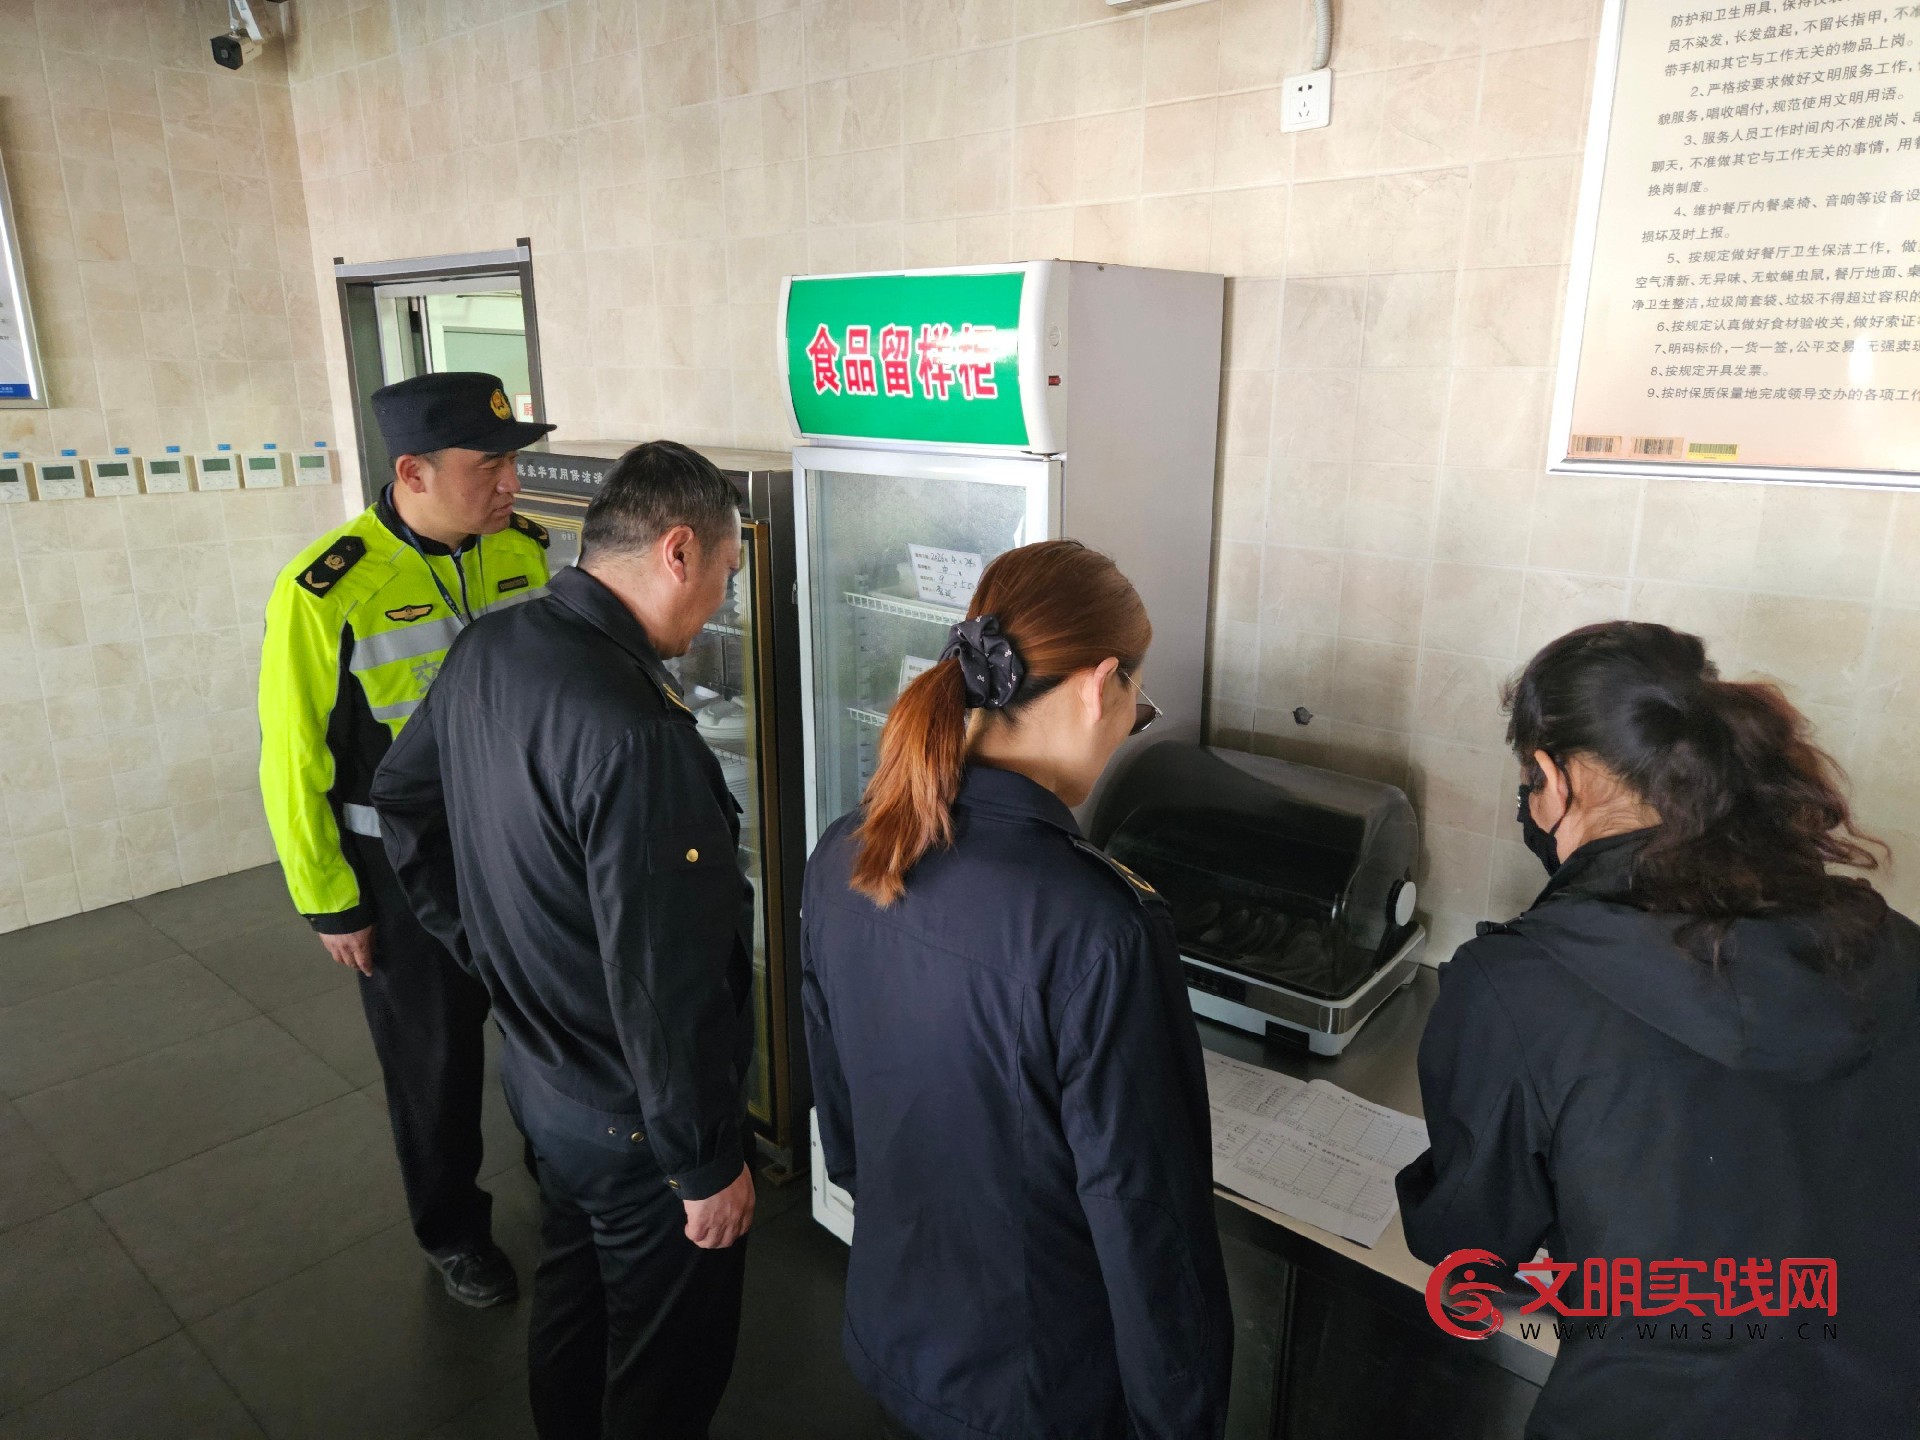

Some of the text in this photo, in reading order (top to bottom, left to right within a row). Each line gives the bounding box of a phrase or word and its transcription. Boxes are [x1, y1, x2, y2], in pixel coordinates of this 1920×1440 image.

[1664, 33, 1914, 77] 带手机和其它与工作无关的物品上岗。
[1690, 60, 1920, 97] 2、严格按要求做好文明服务工作，
[1657, 87, 1904, 125] 貌服务，唱收唱付，规范使用文明用语。
[1647, 180, 1709, 197] 换岗制度。
[1641, 226, 1730, 243] 损坏及时上报。
[1667, 239, 1920, 264] 5、按规定做好餐厅卫生保洁工作，做
[1656, 314, 1920, 332] 6、按规定认真做好食材验收关，做好索证
[806, 323, 998, 400] 食品留样柜
[1650, 364, 1769, 377] 8、按规定开具发票。
